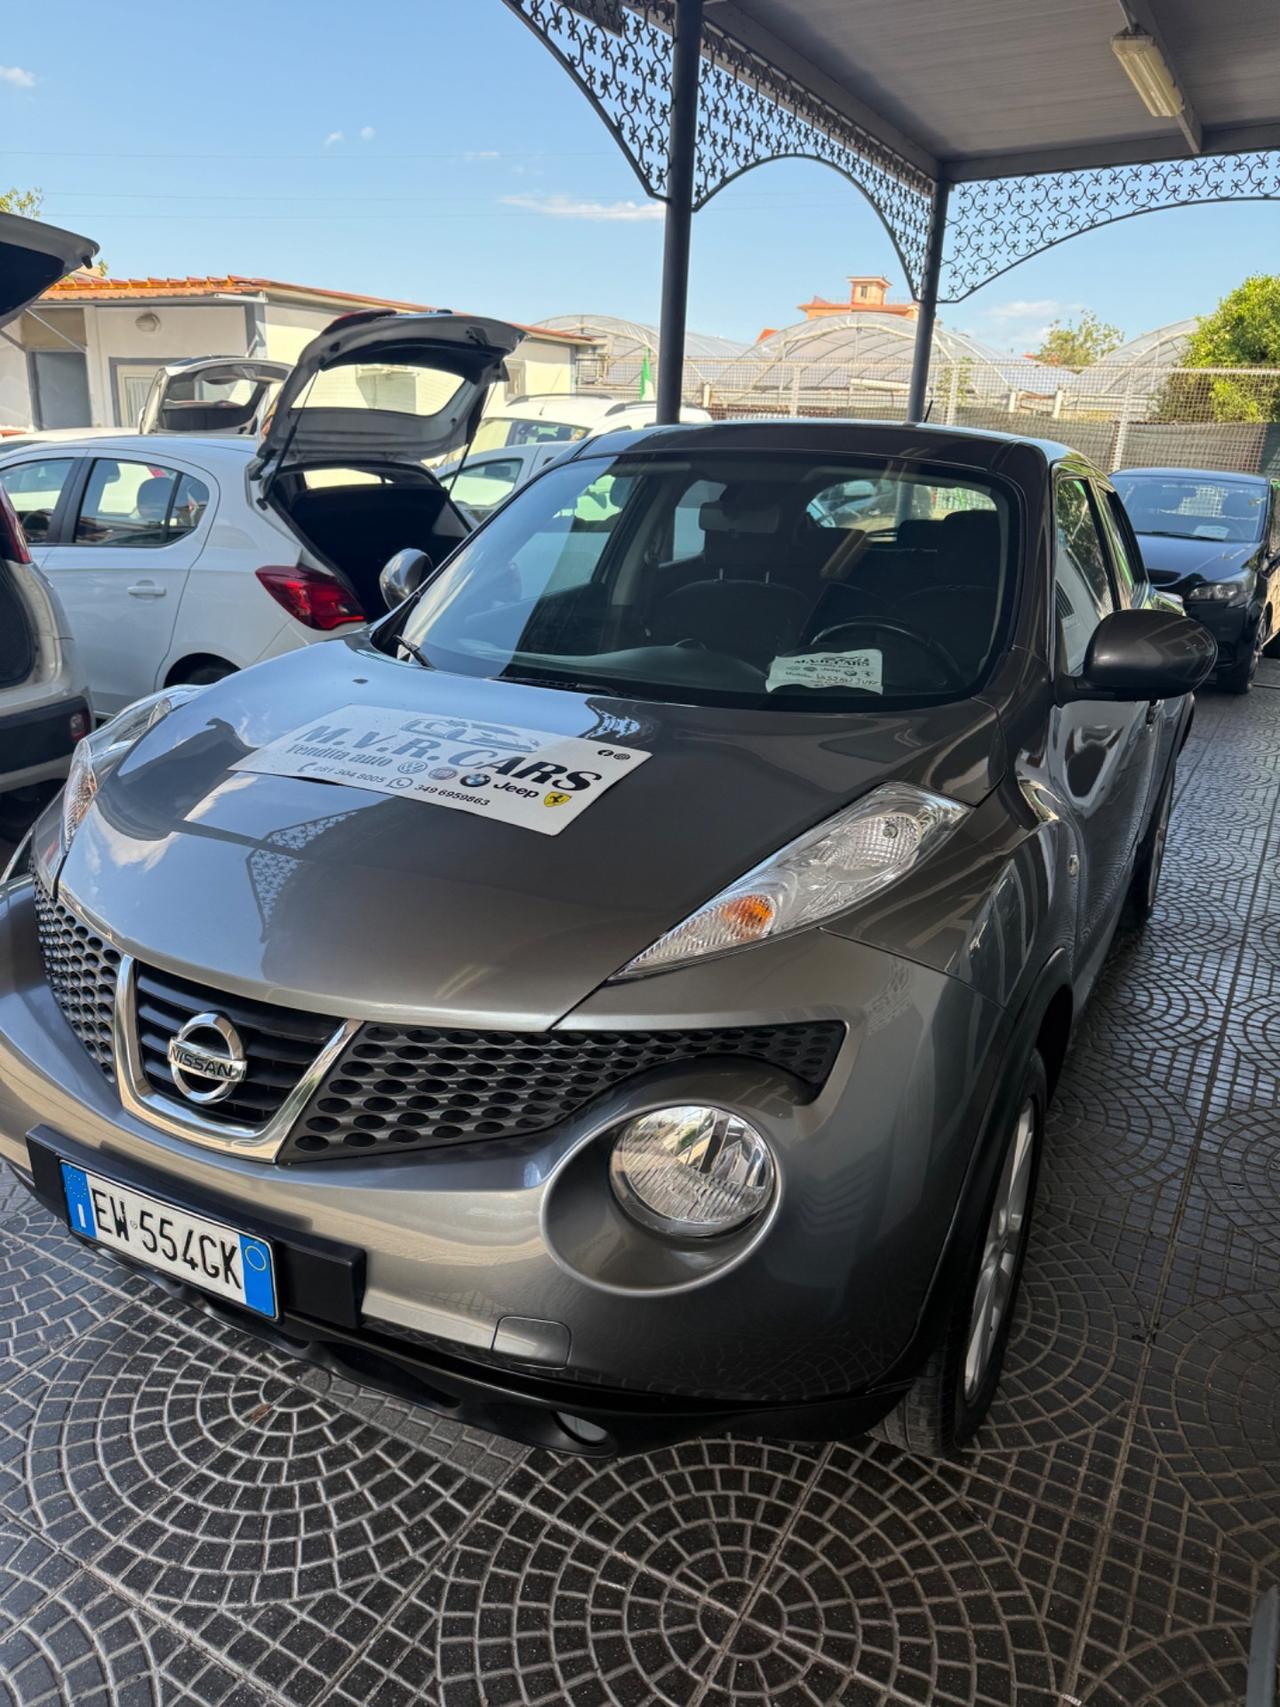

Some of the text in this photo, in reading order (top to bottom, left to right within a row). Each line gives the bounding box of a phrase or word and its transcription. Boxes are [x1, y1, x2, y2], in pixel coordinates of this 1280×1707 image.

[348, 754, 393, 767] auto
[414, 784, 438, 793] 349
[493, 781, 539, 798] Jeep
[170, 1046, 233, 1077] NISSAN
